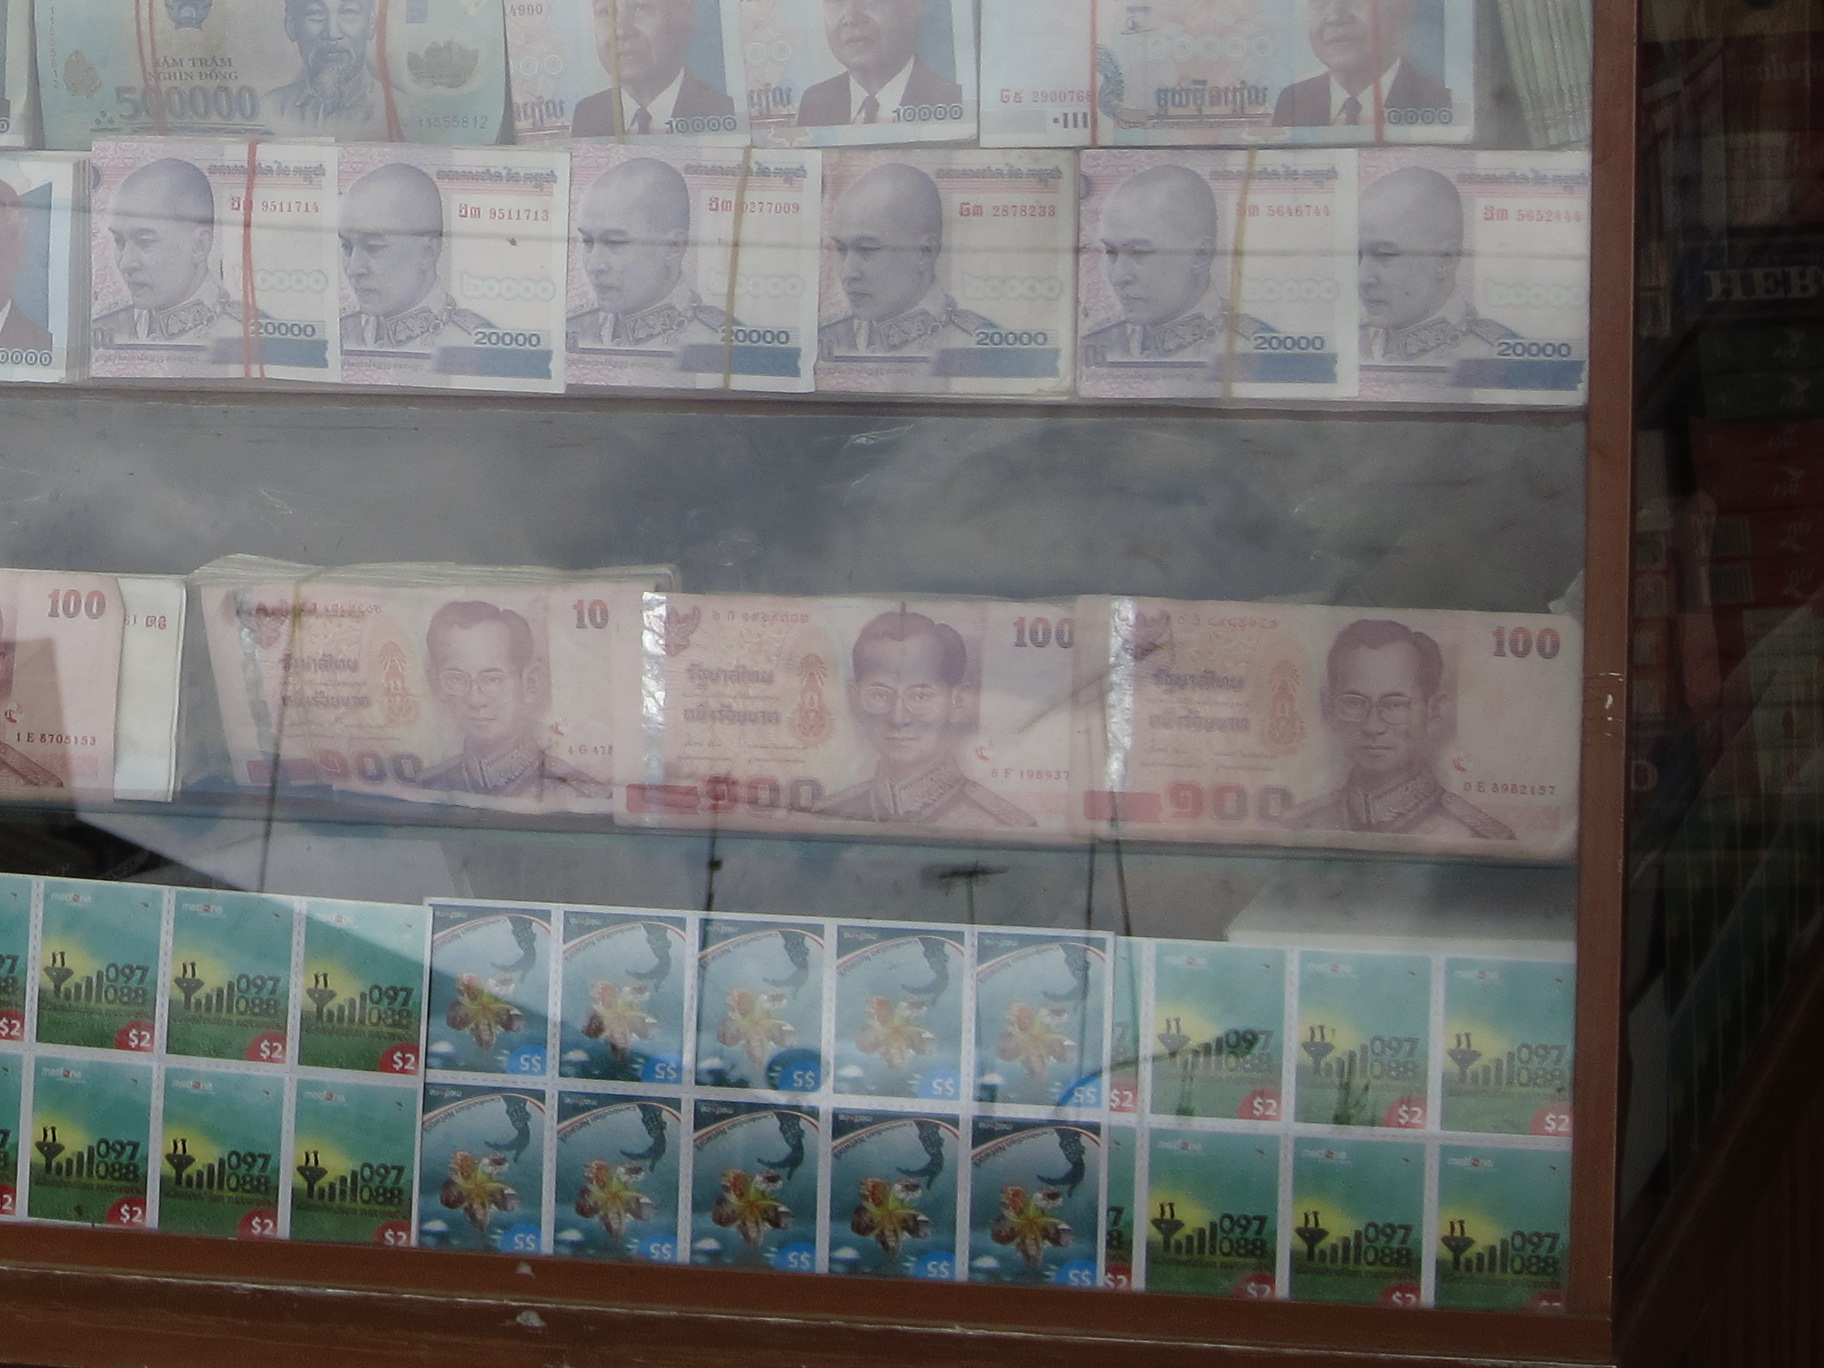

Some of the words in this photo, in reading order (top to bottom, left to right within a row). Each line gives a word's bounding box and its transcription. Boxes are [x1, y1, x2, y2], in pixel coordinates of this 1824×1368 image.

[892, 103, 964, 123] 10000
[1384, 107, 1455, 124] 0000
[665, 115, 737, 134] 10000
[489, 209, 550, 223] 9511713
[474, 330, 542, 348] 20000
[975, 330, 1047, 347] 20000
[1253, 334, 1325, 351] 20000
[1496, 340, 1572, 358] 20000
[48, 589, 106, 619] 100
[1014, 616, 1075, 648] 100
[1493, 625, 1561, 660] 100
[368, 985, 413, 1006] 097
[0, 1017, 22, 1037] $2
[392, 1052, 415, 1071] $2
[1252, 1095, 1278, 1116] $2
[1545, 1111, 1569, 1133] $2
[97, 1138, 140, 1159] 097
[119, 1203, 143, 1224] $2
[1218, 1212, 1269, 1235] 097
